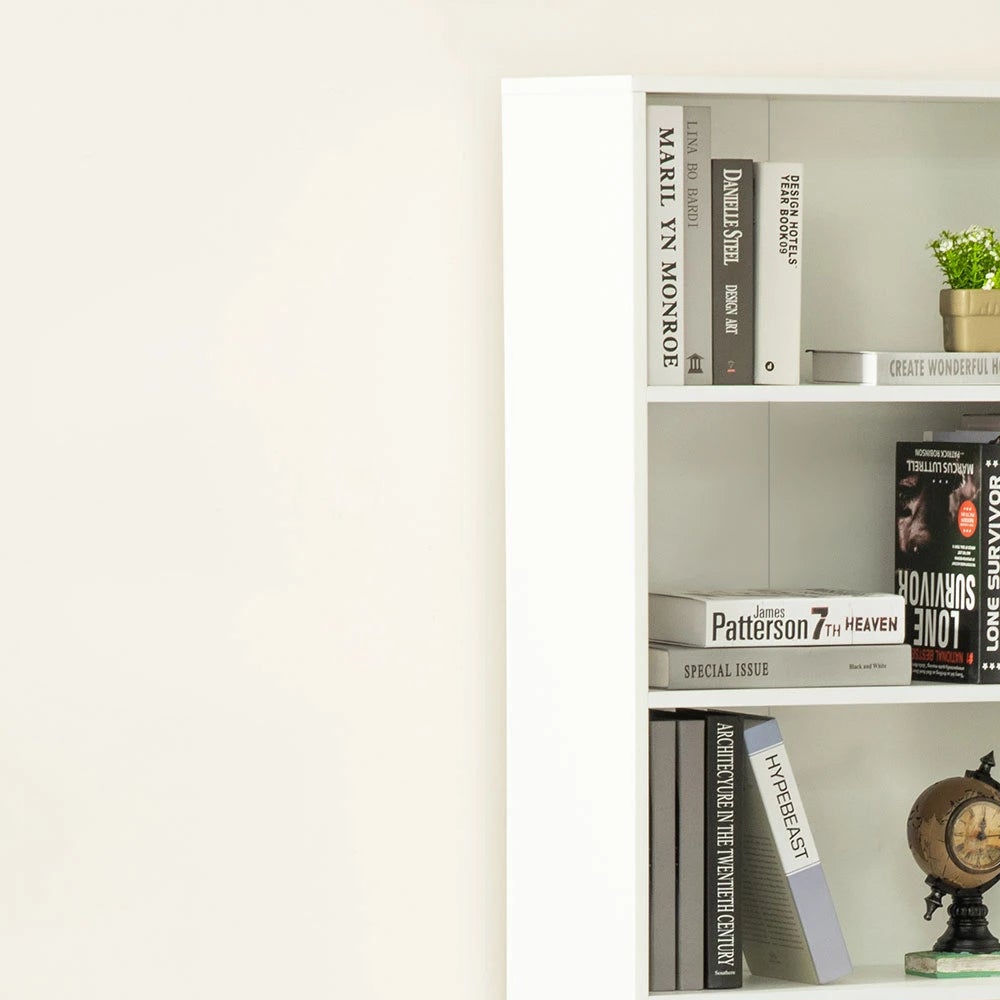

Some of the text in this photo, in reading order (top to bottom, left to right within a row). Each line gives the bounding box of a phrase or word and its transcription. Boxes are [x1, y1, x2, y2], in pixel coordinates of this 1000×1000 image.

[686, 121, 698, 229] LINA BO BARDI
[789, 175, 800, 217] DESIGN
[723, 168, 742, 266] DANIELLE STEEL
[779, 175, 790, 254] YEAR BOOK09
[661, 261, 678, 368] MONROE
[725, 284, 738, 335] DESIGN ART
[890, 359, 925, 377] CREATE
[928, 357, 989, 377] WONDERFUL
[906, 460, 974, 475] MARCUS LUTTRELL
[898, 570, 976, 611] SURVIVOR
[712, 612, 808, 641] Patterson
[845, 616, 898, 633] HEAVEN
[753, 605, 785, 619] James
[914, 608, 960, 649] LONE
[987, 597, 1000, 652] LONE
[684, 662, 769, 679] SPECIAL ISSUE
[717, 810, 734, 823] IN
[765, 754, 809, 861] HYPEBEAST
[717, 824, 734, 846] THE
[717, 848, 734, 912] TWENTIETH
[717, 914, 735, 967] CENTURY
